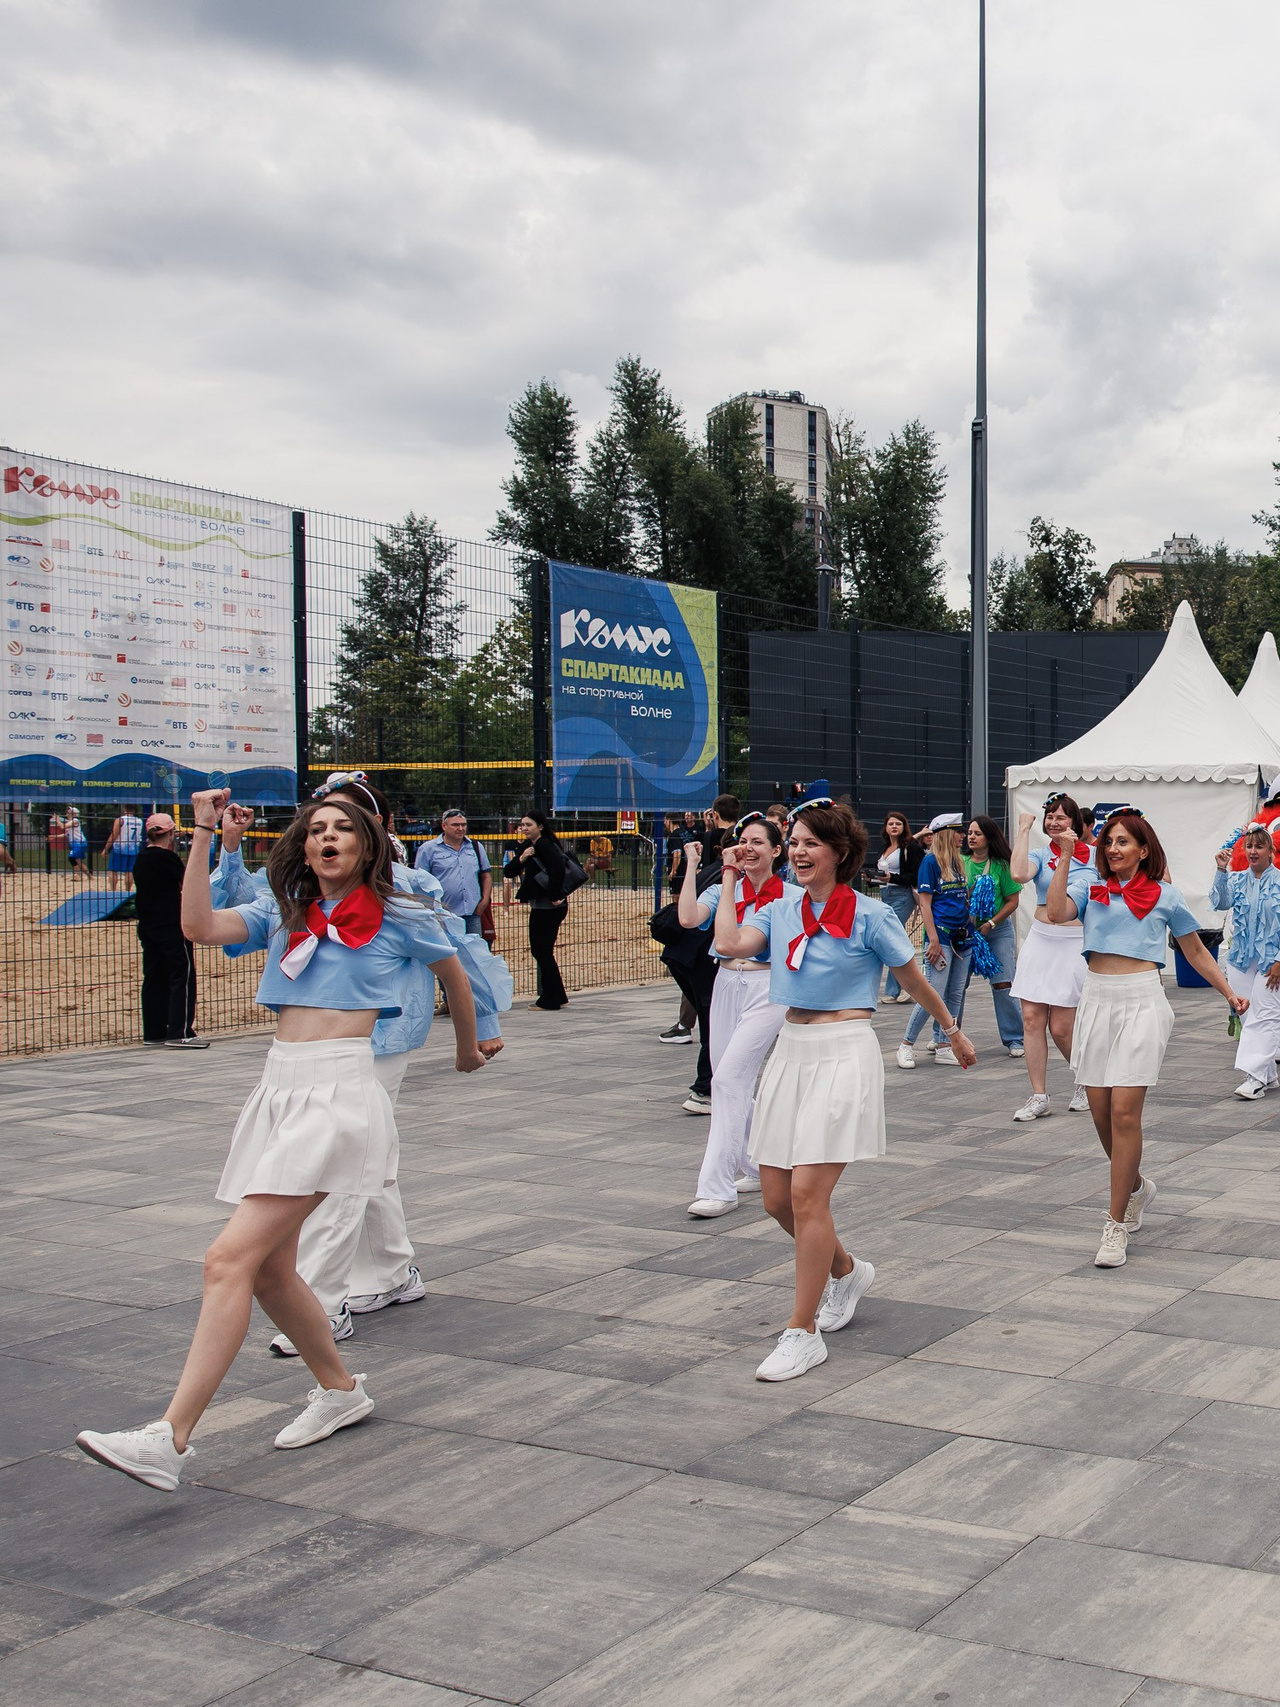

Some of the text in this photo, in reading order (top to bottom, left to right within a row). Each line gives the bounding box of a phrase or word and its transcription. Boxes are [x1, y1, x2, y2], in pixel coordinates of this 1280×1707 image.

[130, 491, 244, 524] СПАРТАКИАДА
[131, 508, 197, 525] на спортивной
[86, 547, 104, 557] ВТБ
[20, 582, 57, 592] РОСКОСМОС
[15, 601, 35, 611] ВТБ
[92, 632, 119, 640] ROSATOM
[226, 666, 241, 674] ВТБ
[561, 658, 685, 690] СПАРТАКИАДА
[51, 692, 69, 701] ВТБ
[562, 685, 644, 702] на спортивной
[172, 721, 188, 730] ВТБ
[9, 733, 45, 741] самолет
[130, 828, 137, 840] 7
